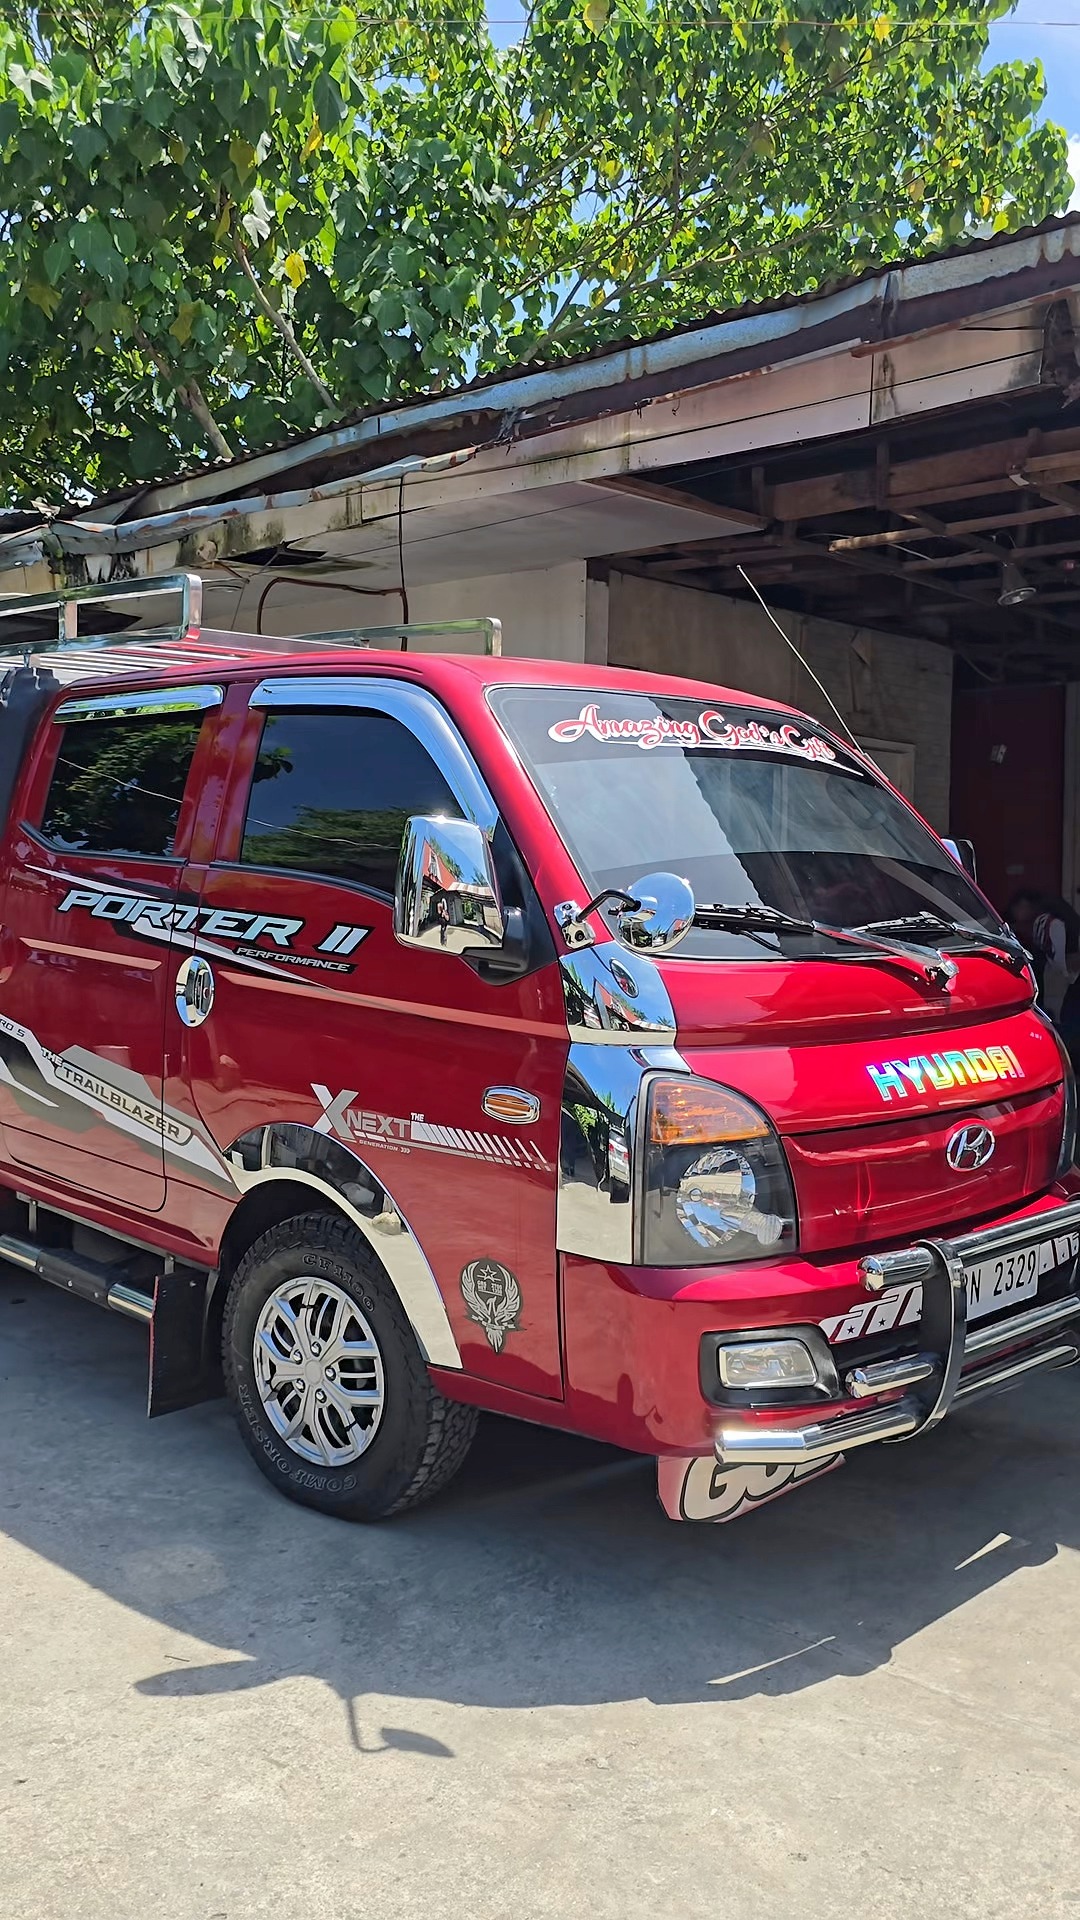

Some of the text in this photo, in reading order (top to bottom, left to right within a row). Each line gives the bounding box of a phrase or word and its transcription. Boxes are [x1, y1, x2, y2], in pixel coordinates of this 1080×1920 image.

[548, 703, 699, 747] Amazing
[58, 889, 303, 946] PORTER
[236, 947, 349, 972] PERFORMANCE
[41, 1047, 63, 1067] THE
[866, 1045, 1025, 1101] HYUNDAI
[62, 1066, 182, 1140] TRAILBLAZER
[346, 1109, 411, 1138] NEXT
[411, 1112, 425, 1122] THE
[359, 1139, 398, 1152] GENERATION
[993, 1250, 1036, 1297] 2329
